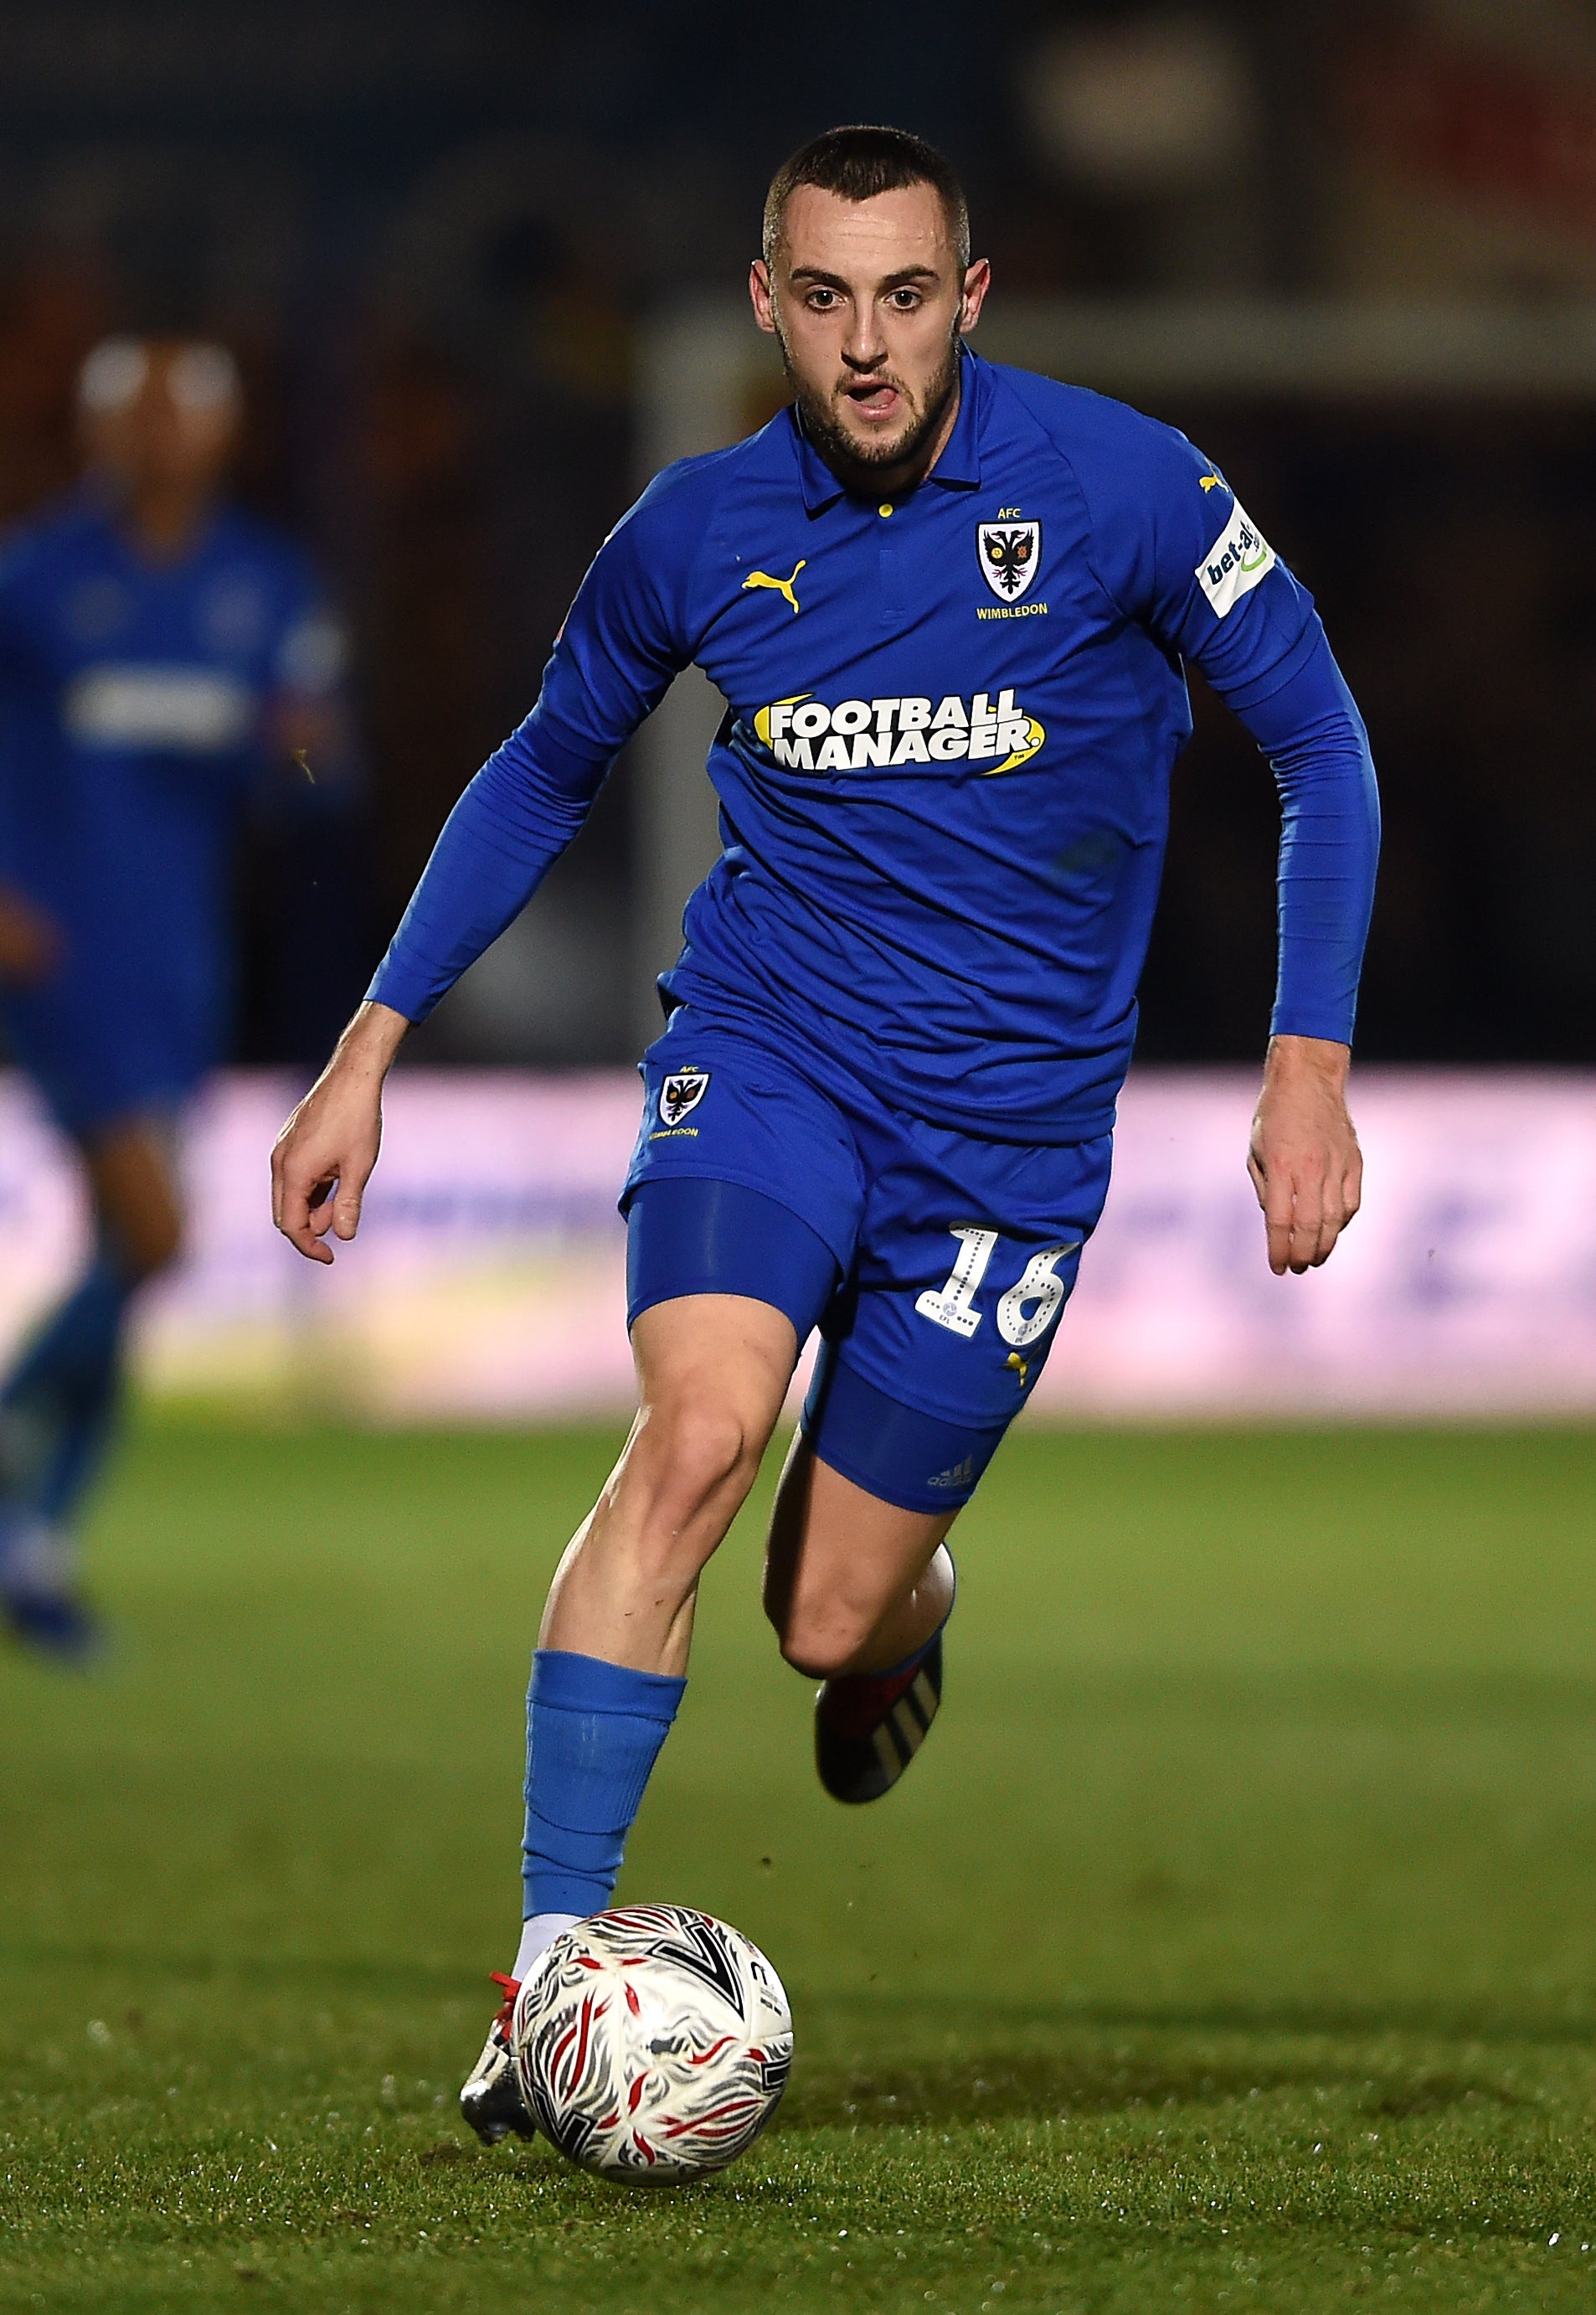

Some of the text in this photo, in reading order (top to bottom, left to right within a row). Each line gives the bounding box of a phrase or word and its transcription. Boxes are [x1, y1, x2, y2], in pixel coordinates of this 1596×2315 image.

[997, 508, 1021, 519] AFC
[976, 602, 1048, 620] WIMBLEDON
[770, 688, 1022, 739] FOOTBALL
[914, 1220, 1080, 1346] 16
